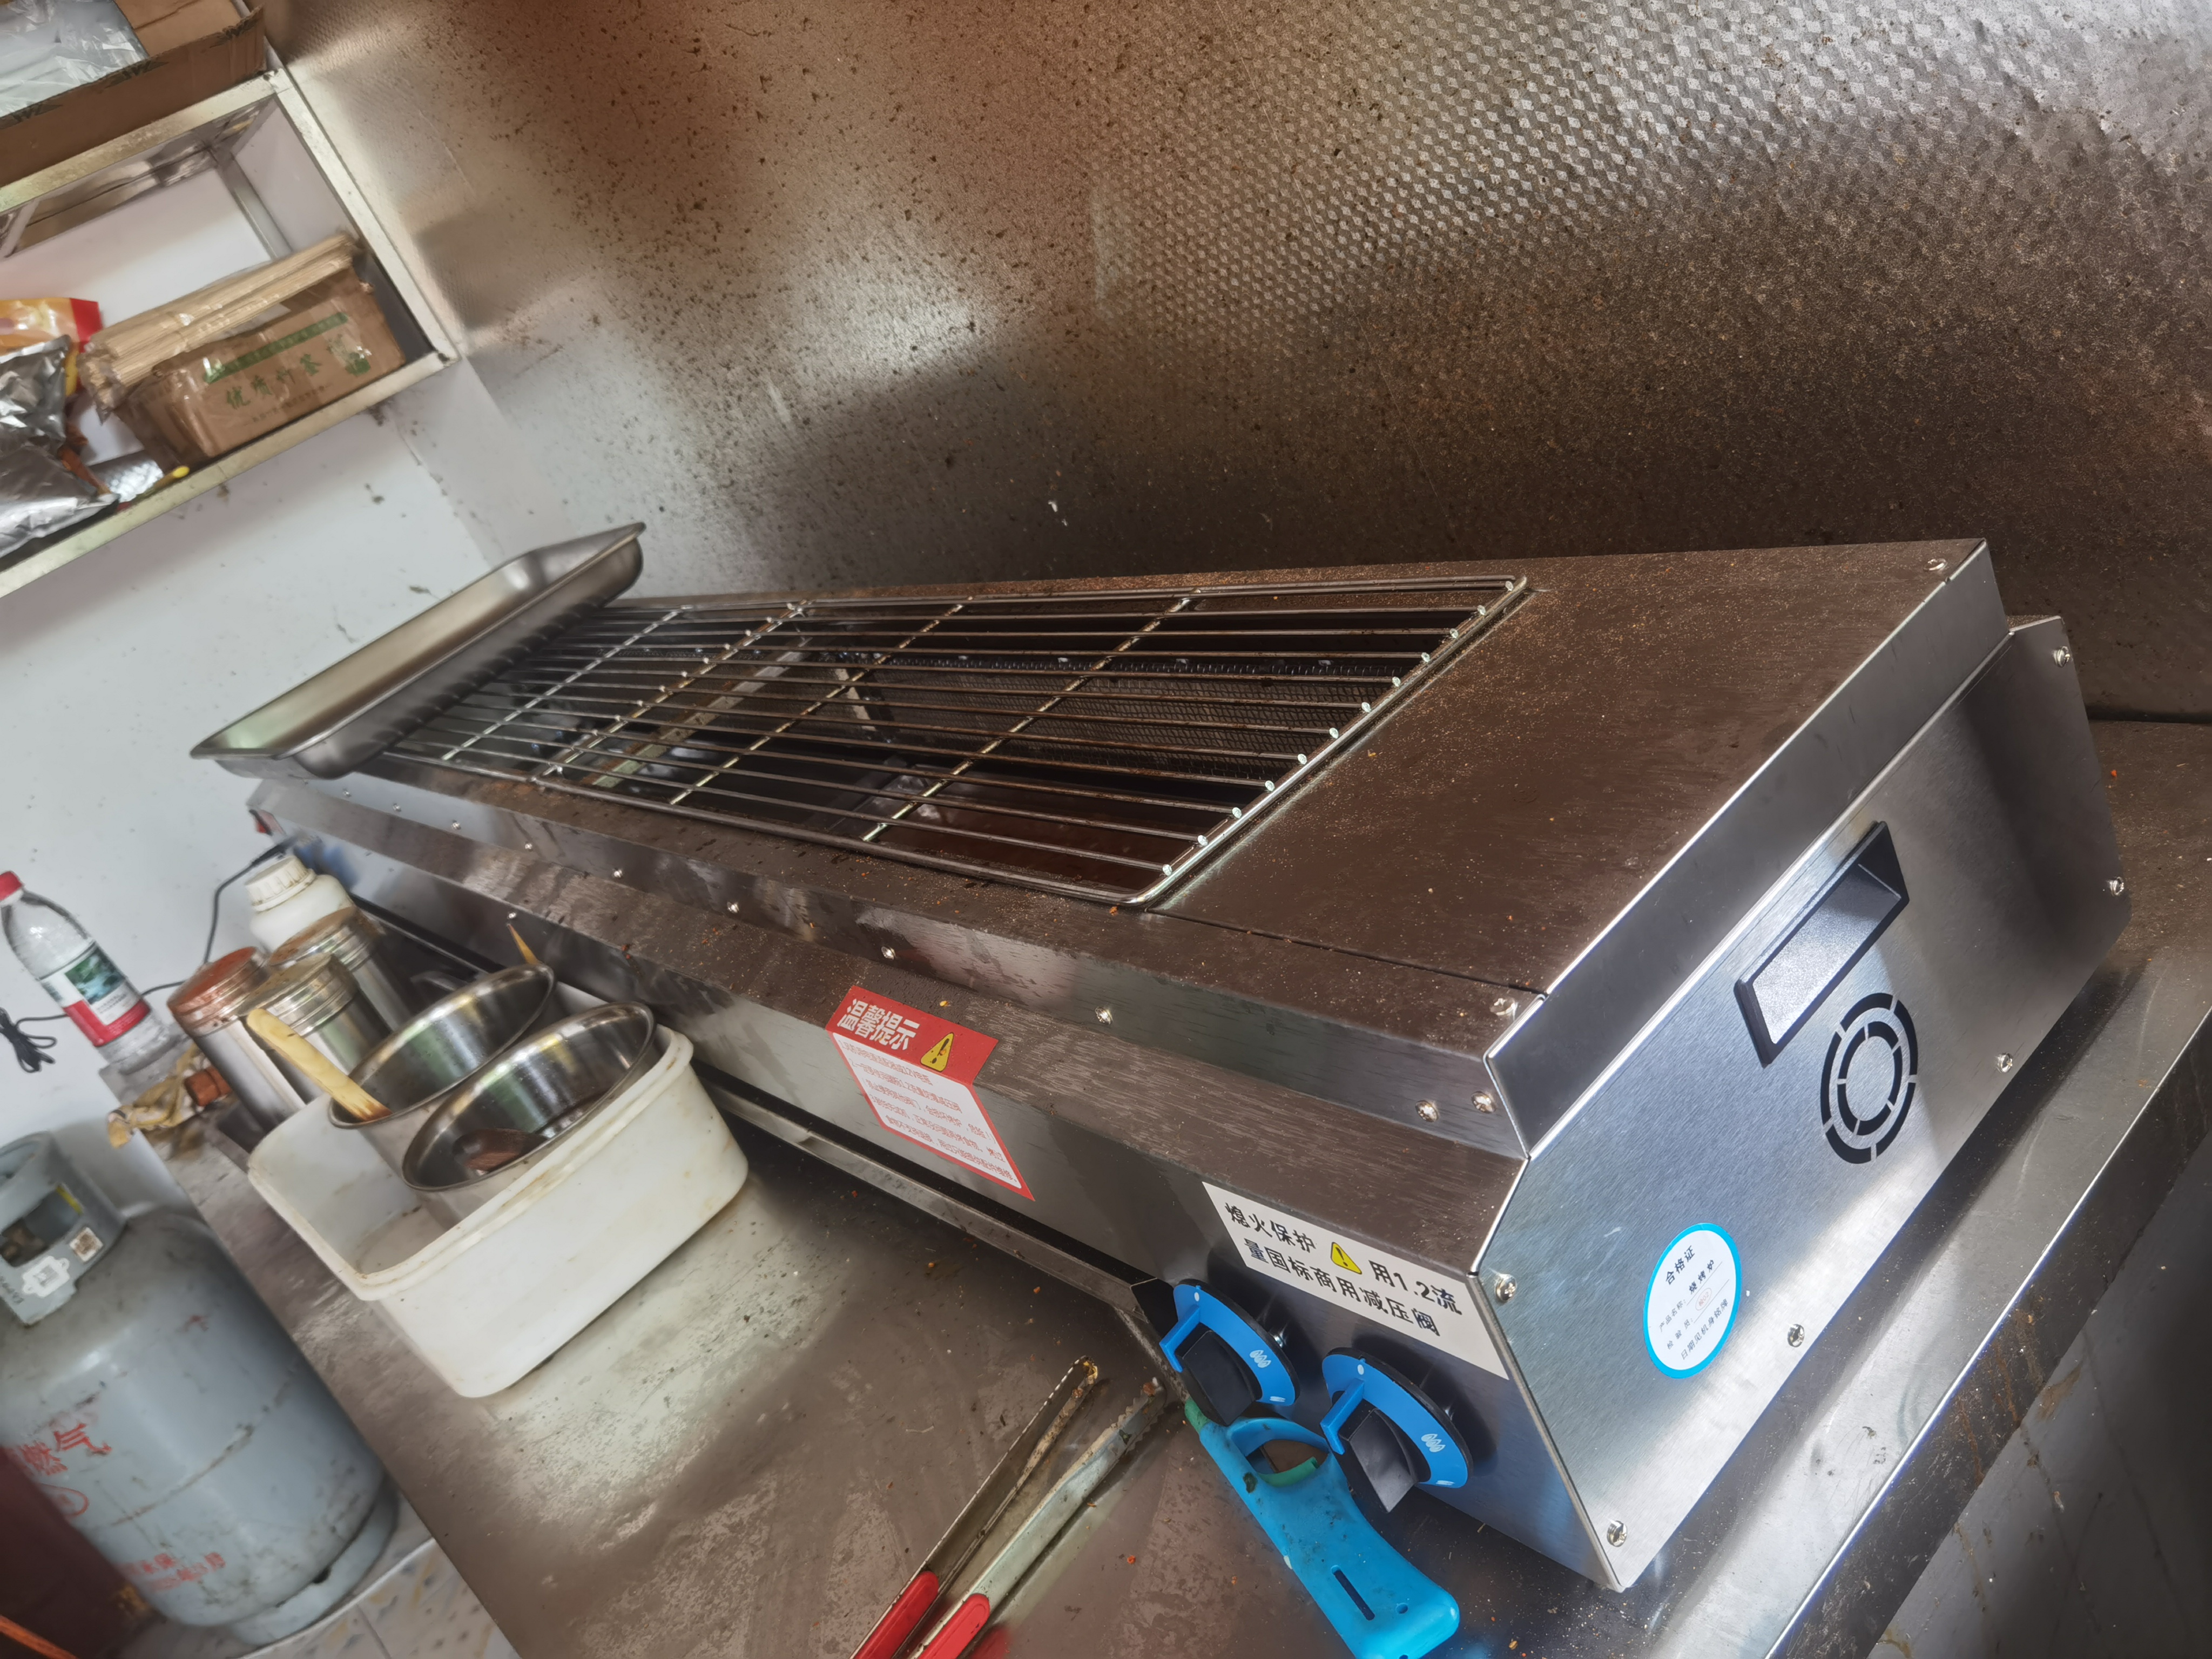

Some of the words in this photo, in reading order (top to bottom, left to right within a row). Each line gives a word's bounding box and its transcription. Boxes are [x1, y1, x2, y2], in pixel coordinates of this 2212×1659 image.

[837, 998, 920, 1050] 温馨提示
[1224, 1202, 1317, 1253] 熄火保护
[1368, 1259, 1463, 1316] 用1.2流
[1243, 1237, 1441, 1337] 量国标商用减压阀
[1664, 1245, 1696, 1285] 合格证
[1680, 1298, 1729, 1360] 日期见机身铭牌
